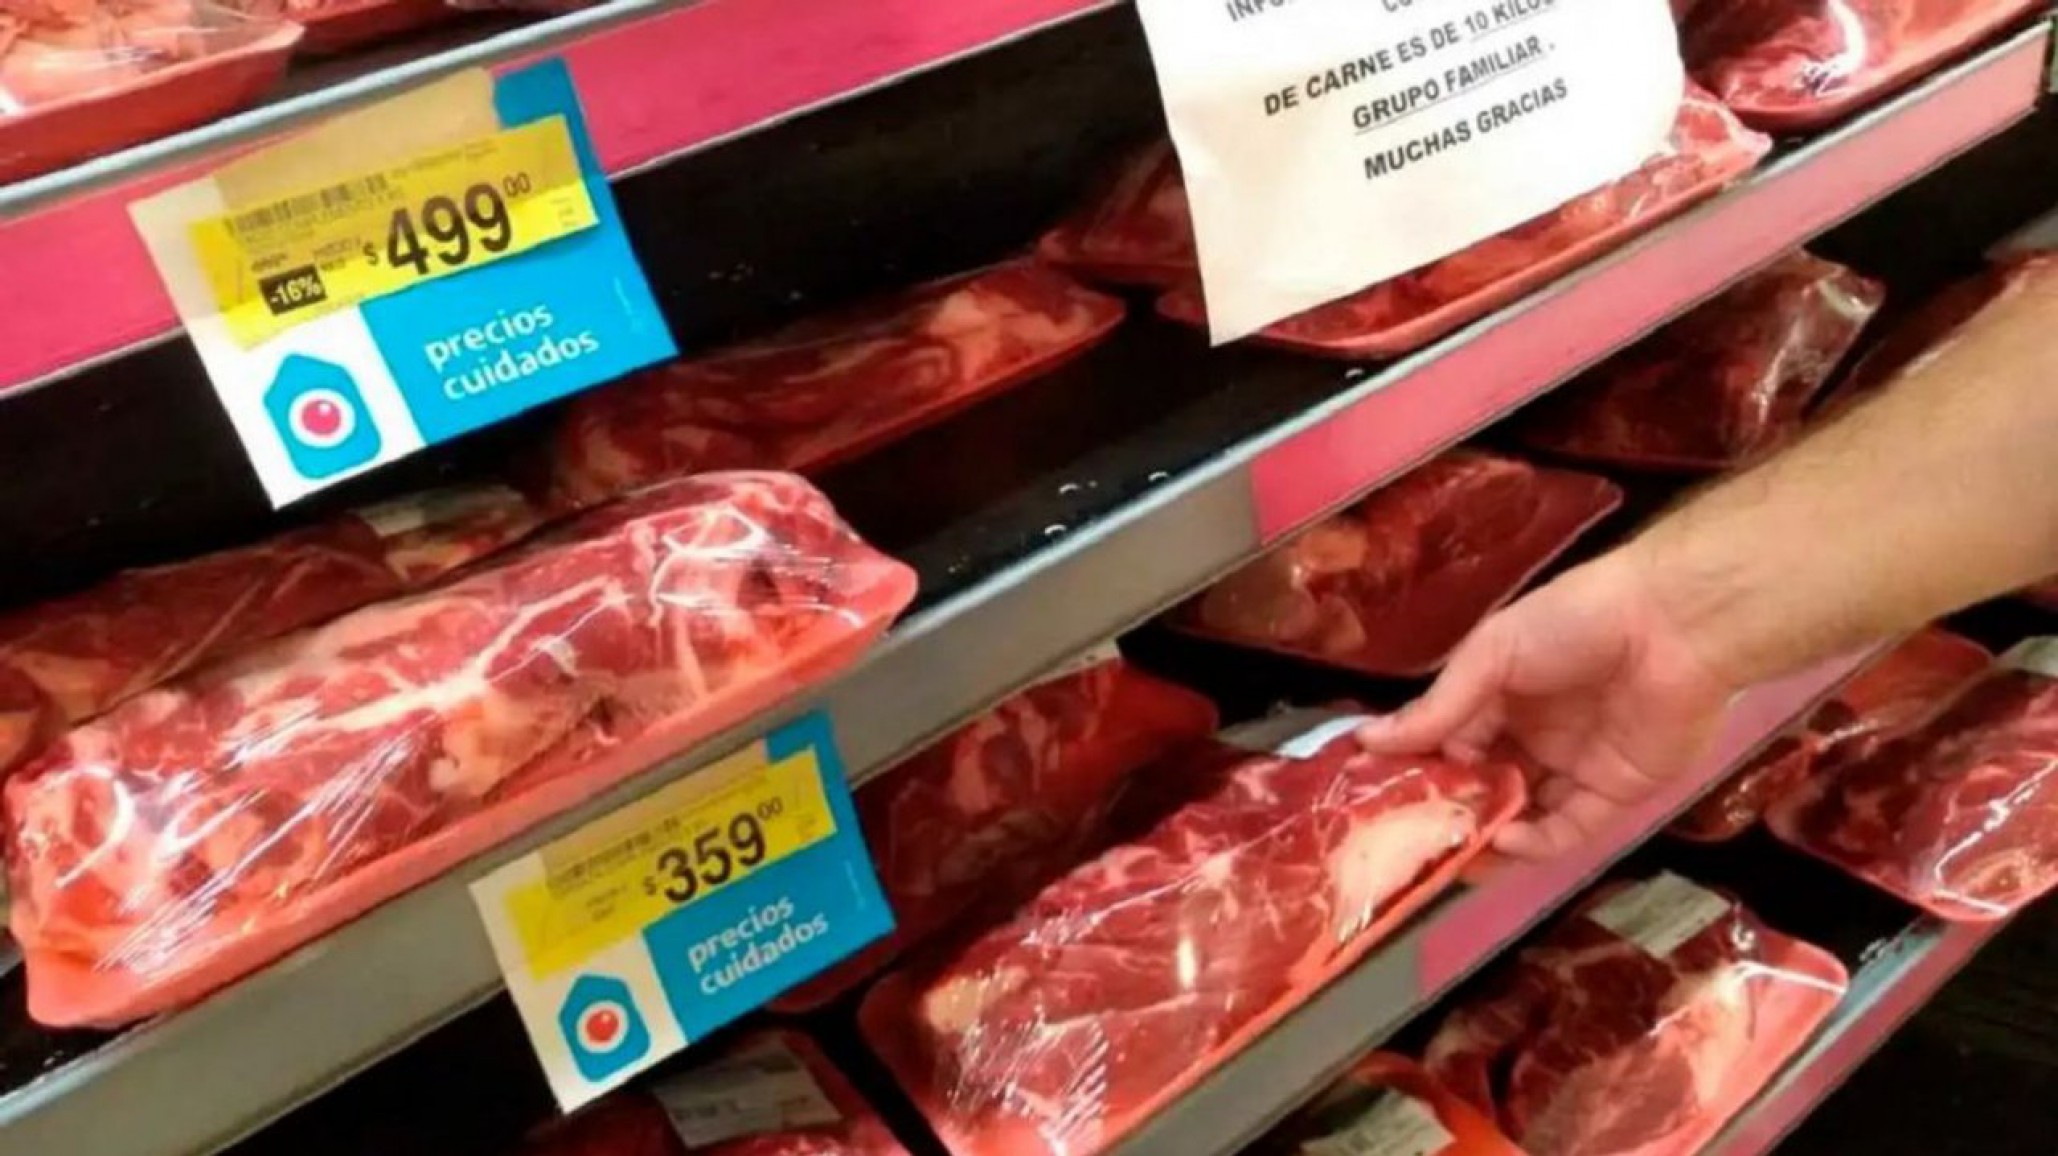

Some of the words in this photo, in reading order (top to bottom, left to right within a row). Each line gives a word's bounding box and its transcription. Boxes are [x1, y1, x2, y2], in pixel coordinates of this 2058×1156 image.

[1264, 85, 1299, 116] DE
[1305, 50, 1393, 99] CARNE
[1397, 36, 1427, 63] ES
[1430, 21, 1460, 50] DE
[1464, 11, 1489, 33] 10
[1353, 78, 1440, 128] GRUPO
[1444, 35, 1542, 92] FAMILIAR
[1364, 120, 1471, 179] MUCHAS
[1476, 77, 1567, 133] GRACIAS
[270, 275, 322, 305] -16%
[425, 304, 554, 374] precios
[444, 331, 599, 400] cuidados
[688, 897, 794, 974] precios
[700, 912, 829, 995] cuidados
